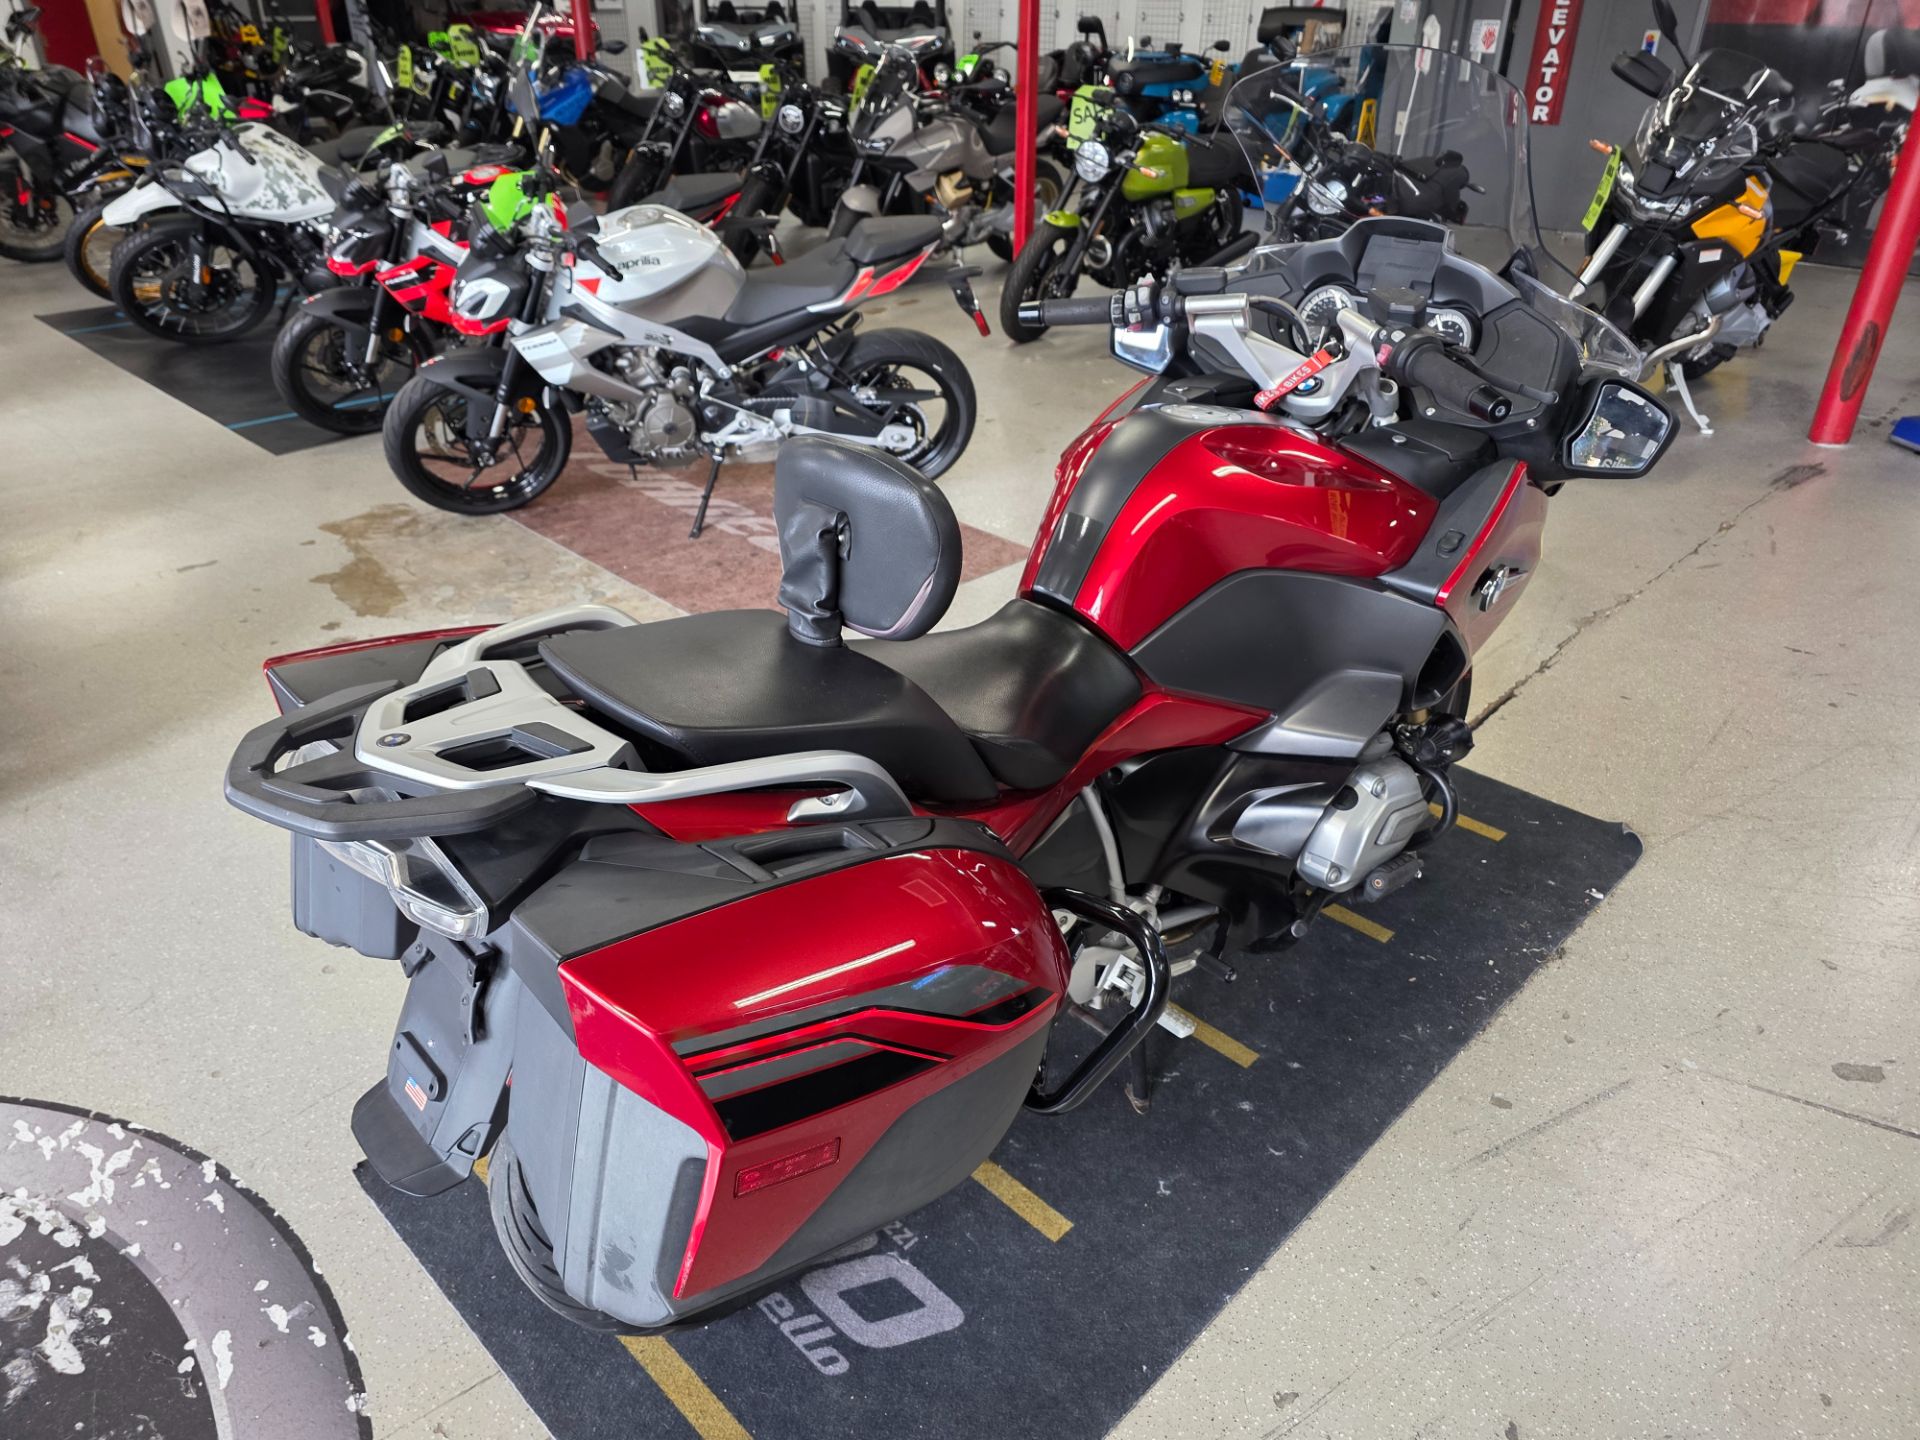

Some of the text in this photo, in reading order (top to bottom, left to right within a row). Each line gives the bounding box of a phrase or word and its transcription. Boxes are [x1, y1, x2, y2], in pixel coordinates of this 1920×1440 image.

[617, 255, 661, 270] aprilia
[1285, 366, 1312, 389] BIKES
[755, 1291, 850, 1376] ello
